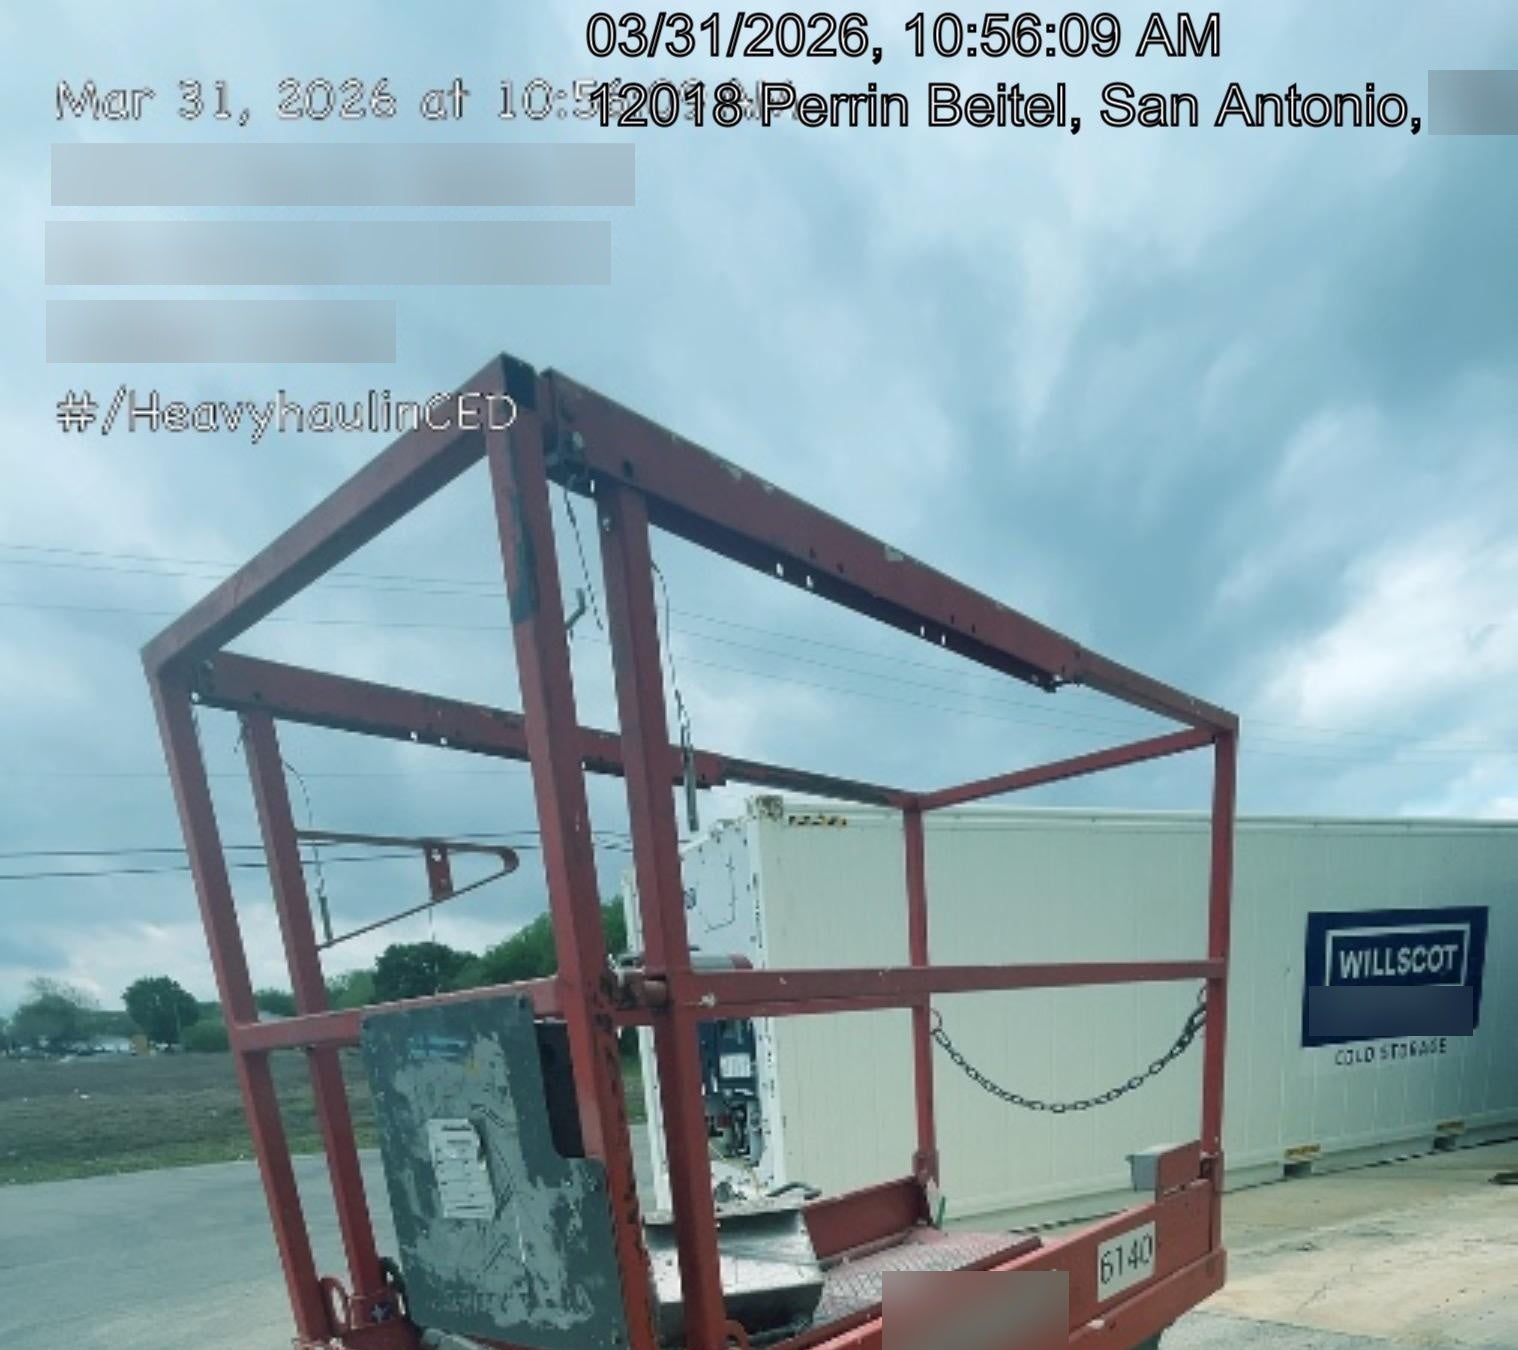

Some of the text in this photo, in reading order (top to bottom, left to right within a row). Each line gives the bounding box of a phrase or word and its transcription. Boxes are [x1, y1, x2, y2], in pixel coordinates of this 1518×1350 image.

[1339, 943, 1459, 979] WILLSCOT
[1335, 1037, 1447, 1065] COLD STORAGE
[1100, 1232, 1153, 1285] 6140
